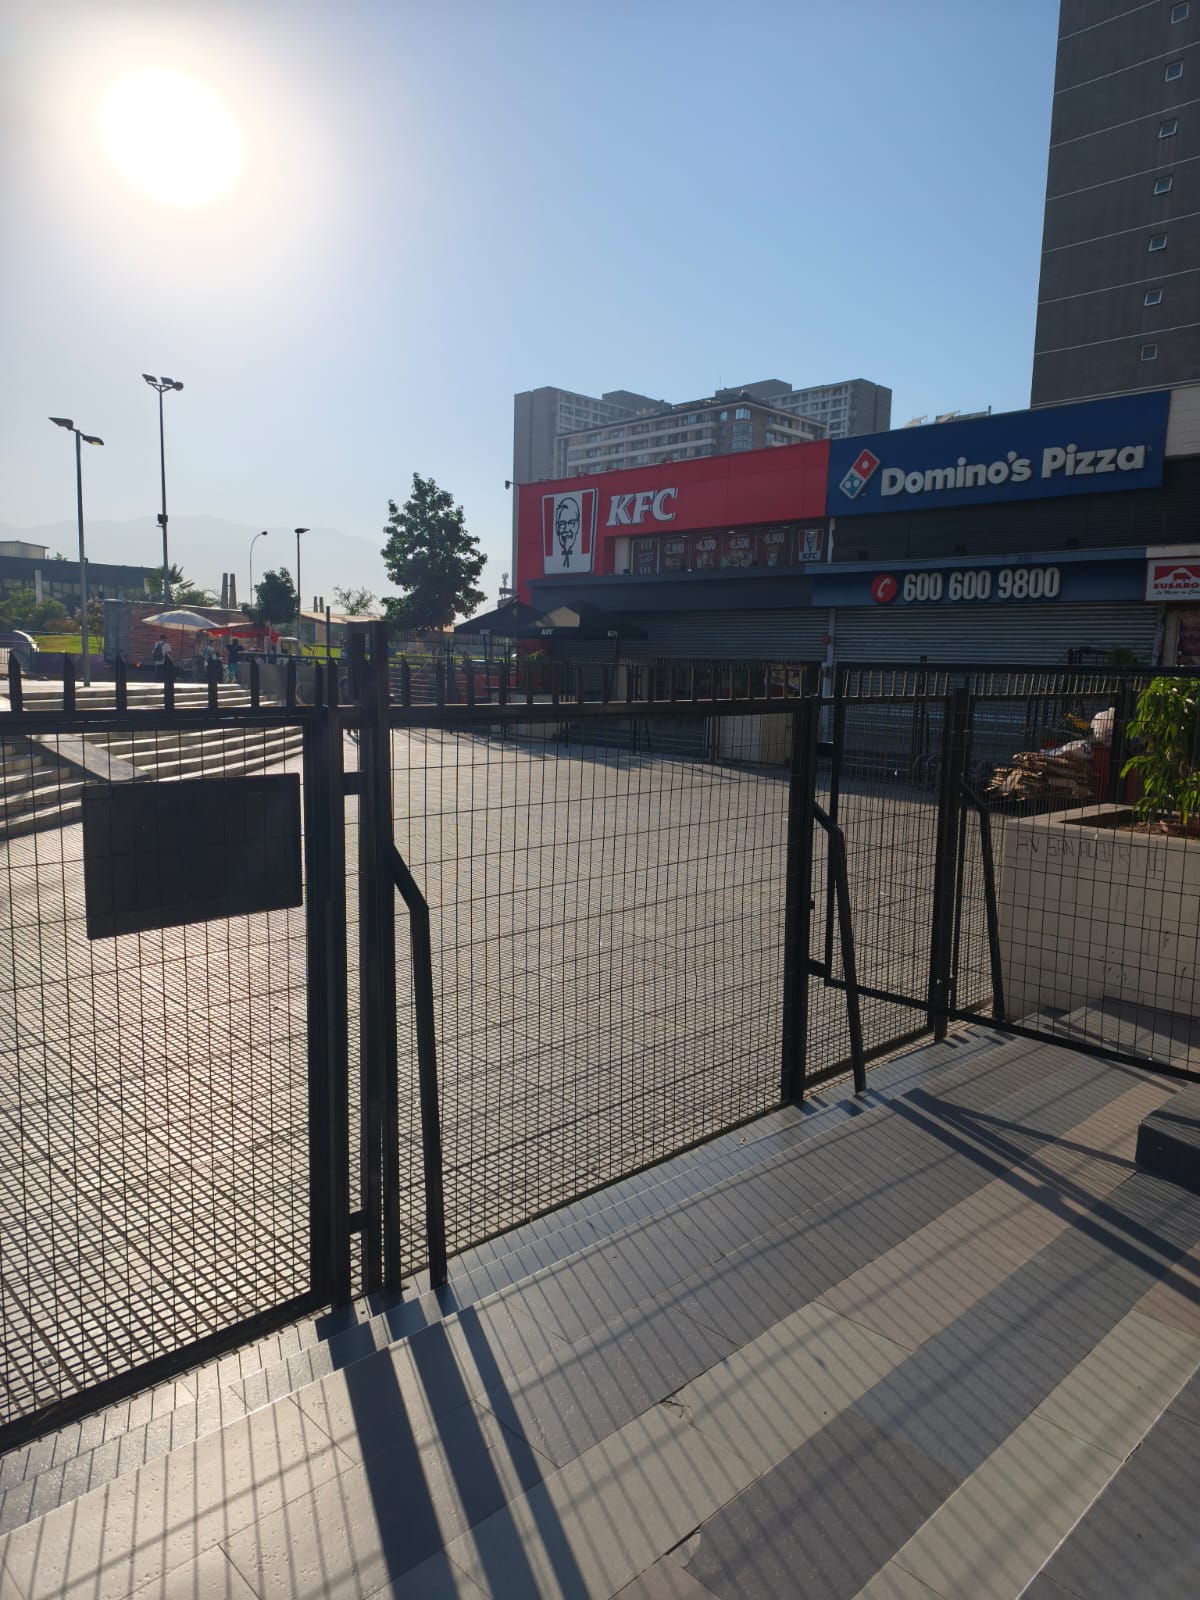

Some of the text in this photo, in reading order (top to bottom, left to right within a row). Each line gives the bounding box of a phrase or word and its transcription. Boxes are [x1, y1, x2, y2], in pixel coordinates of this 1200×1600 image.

[880, 443, 1146, 496] Domino's Pizza
[606, 487, 679, 527] KFC
[903, 567, 1061, 602] 600 600 9800
